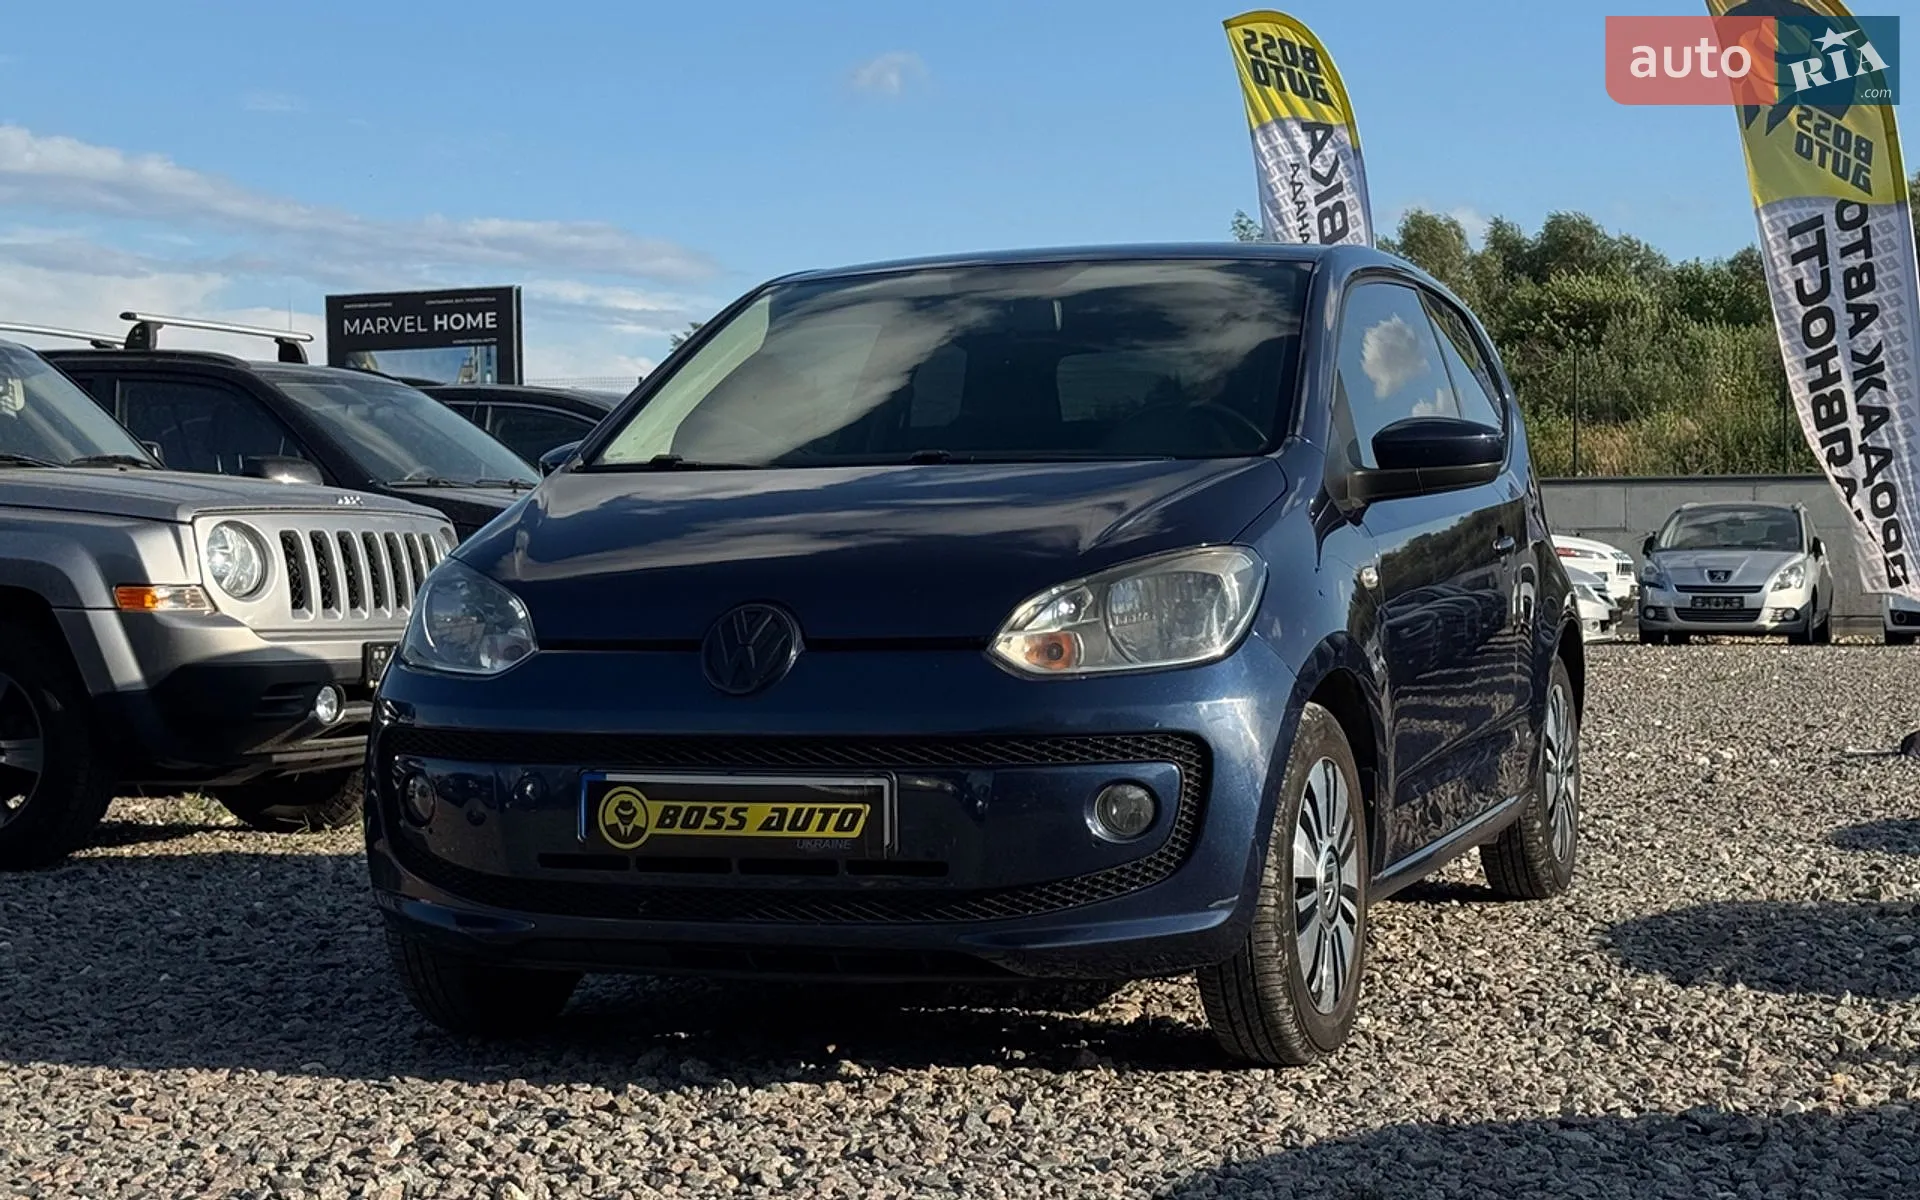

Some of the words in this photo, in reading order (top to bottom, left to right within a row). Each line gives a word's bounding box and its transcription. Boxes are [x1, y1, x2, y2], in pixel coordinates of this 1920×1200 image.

[343, 315, 428, 336] MARVEL
[433, 311, 498, 331] HOME
[655, 804, 749, 831] BOSS
[757, 806, 865, 833] AUTO
[796, 839, 852, 850] UKRAINE
